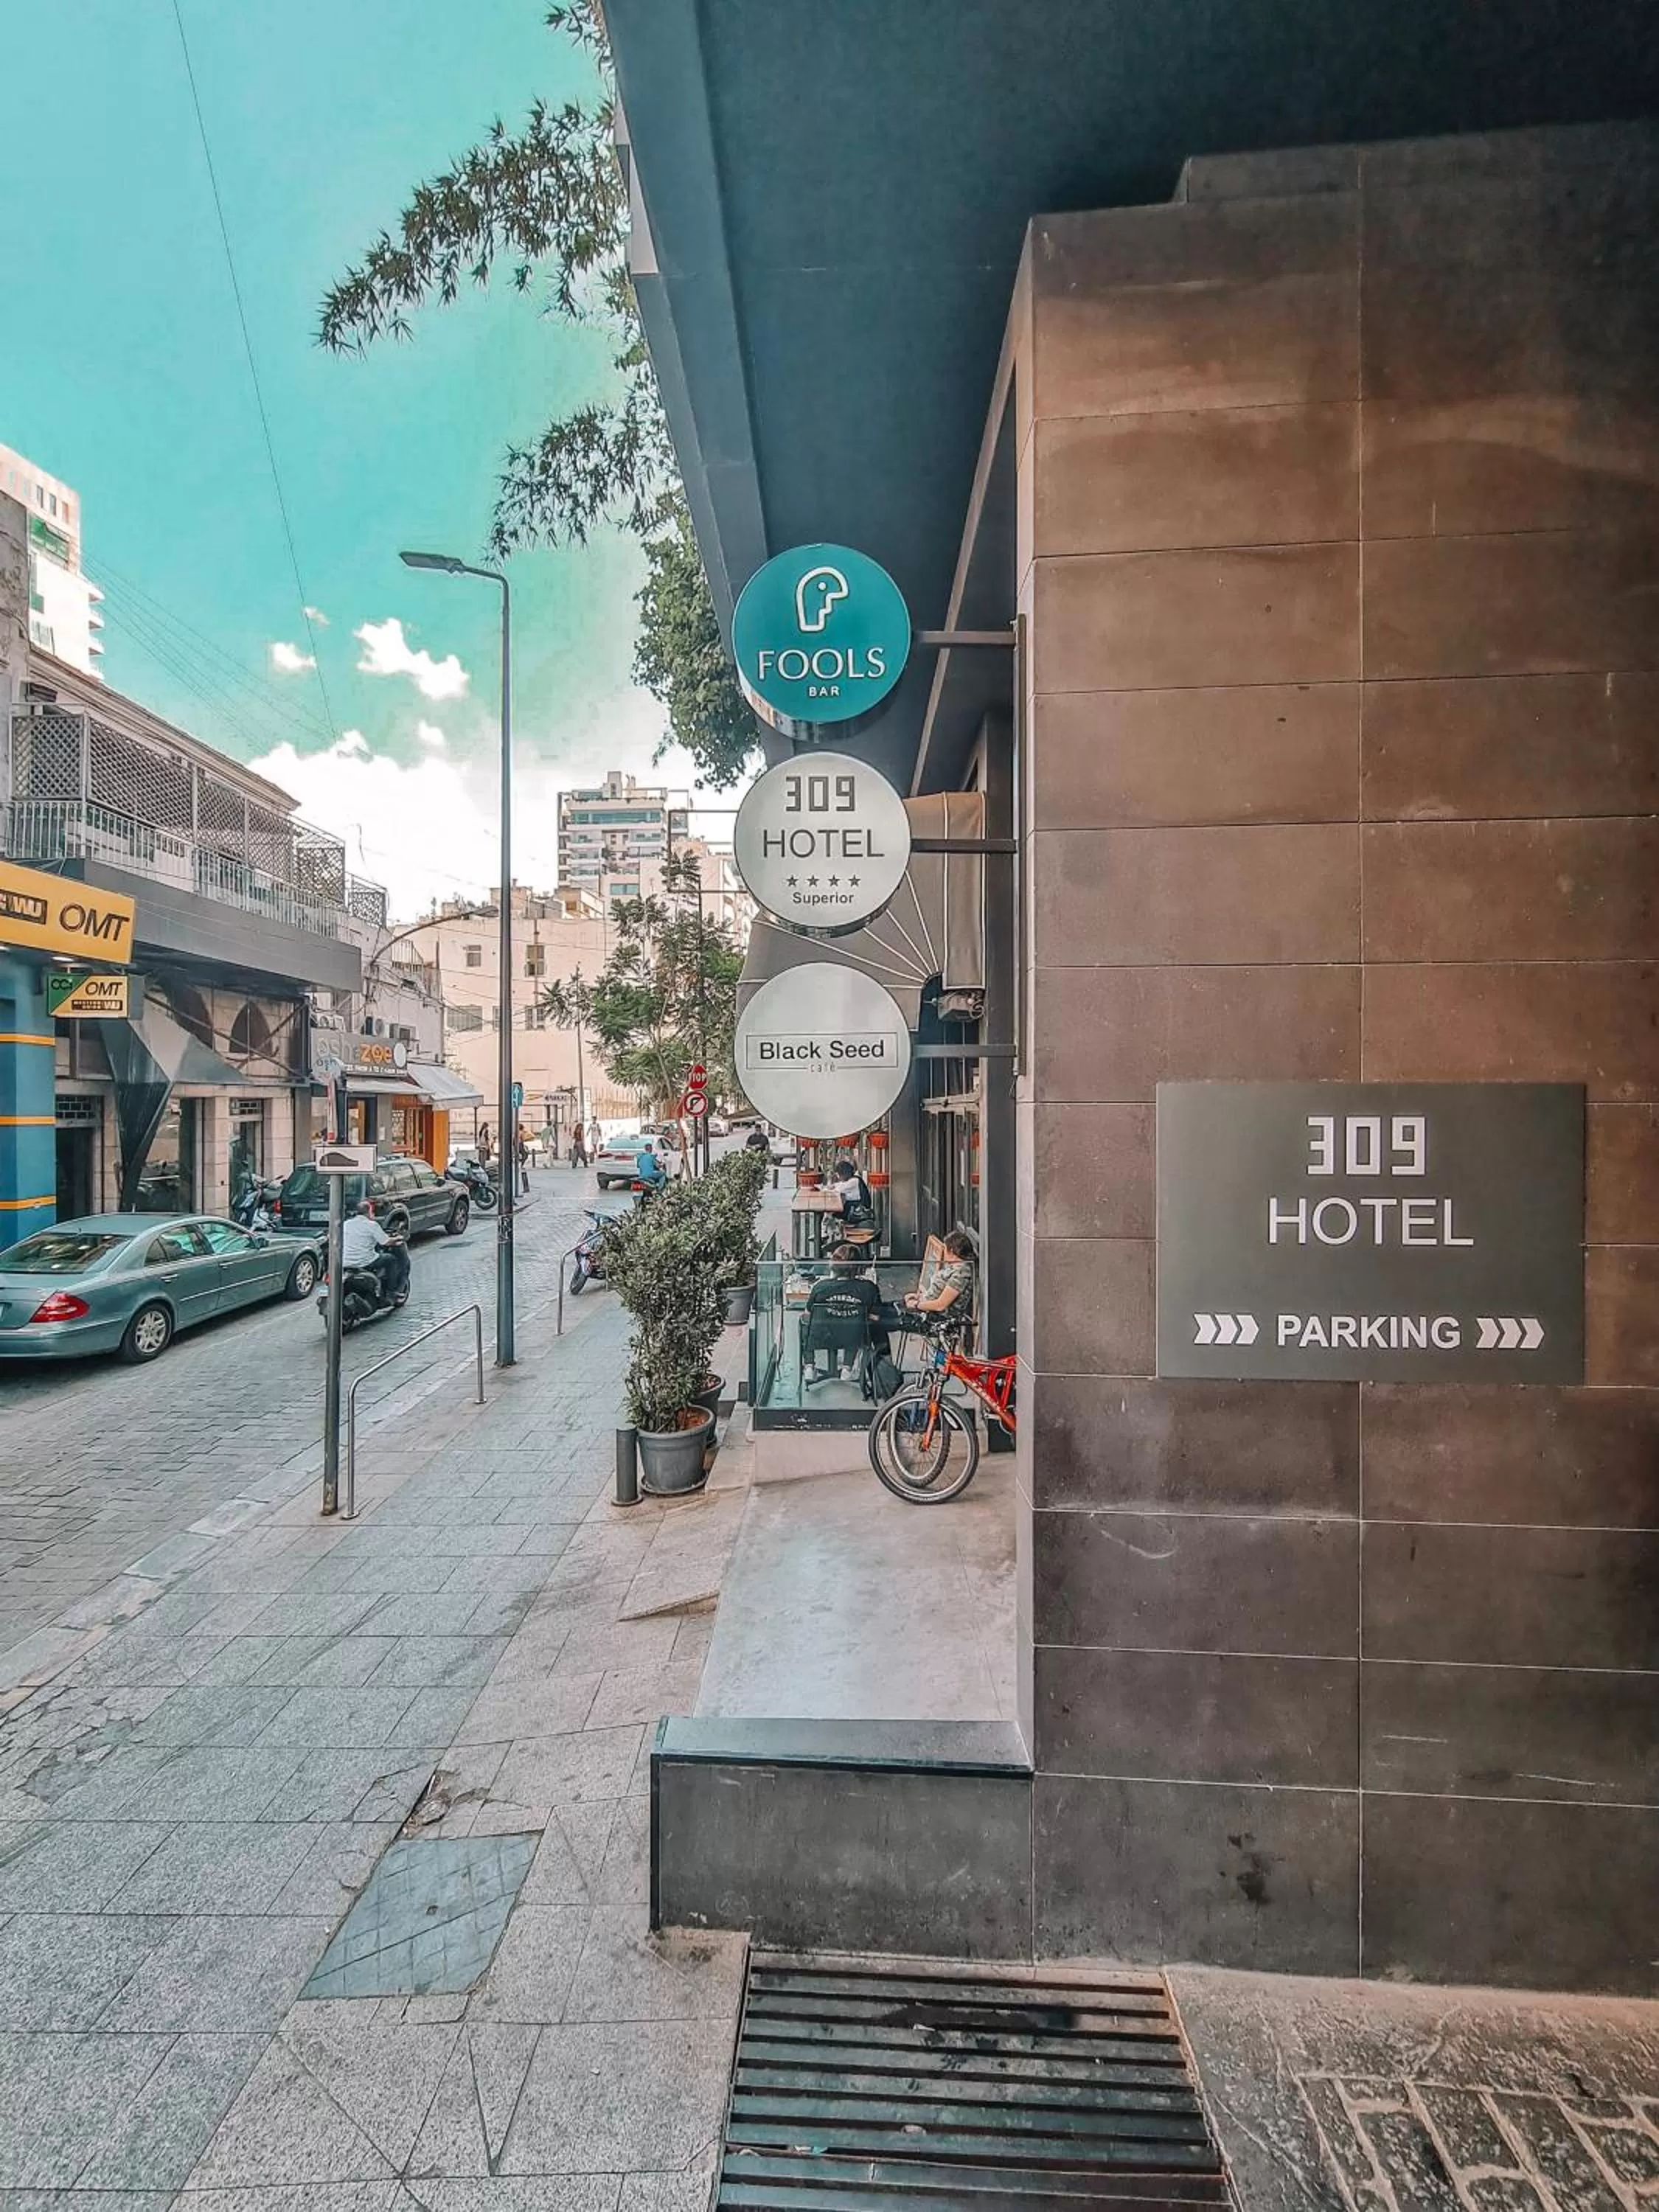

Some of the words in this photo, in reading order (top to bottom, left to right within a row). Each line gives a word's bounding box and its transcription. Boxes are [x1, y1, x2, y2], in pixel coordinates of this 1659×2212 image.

[758, 648, 886, 680] FOOLS
[808, 686, 841, 697] BAR
[785, 776, 855, 812] 309
[763, 829, 885, 858] HOTEL
[792, 892, 855, 905] Superior
[59, 903, 130, 941] OMT
[85, 981, 123, 996] OMT
[760, 1042, 821, 1060] Black
[830, 1040, 885, 1058] Seed
[1307, 1116, 1426, 1175] 309
[1268, 1197, 1474, 1246] HOTEL
[1277, 1315, 1461, 1349] PARKING
